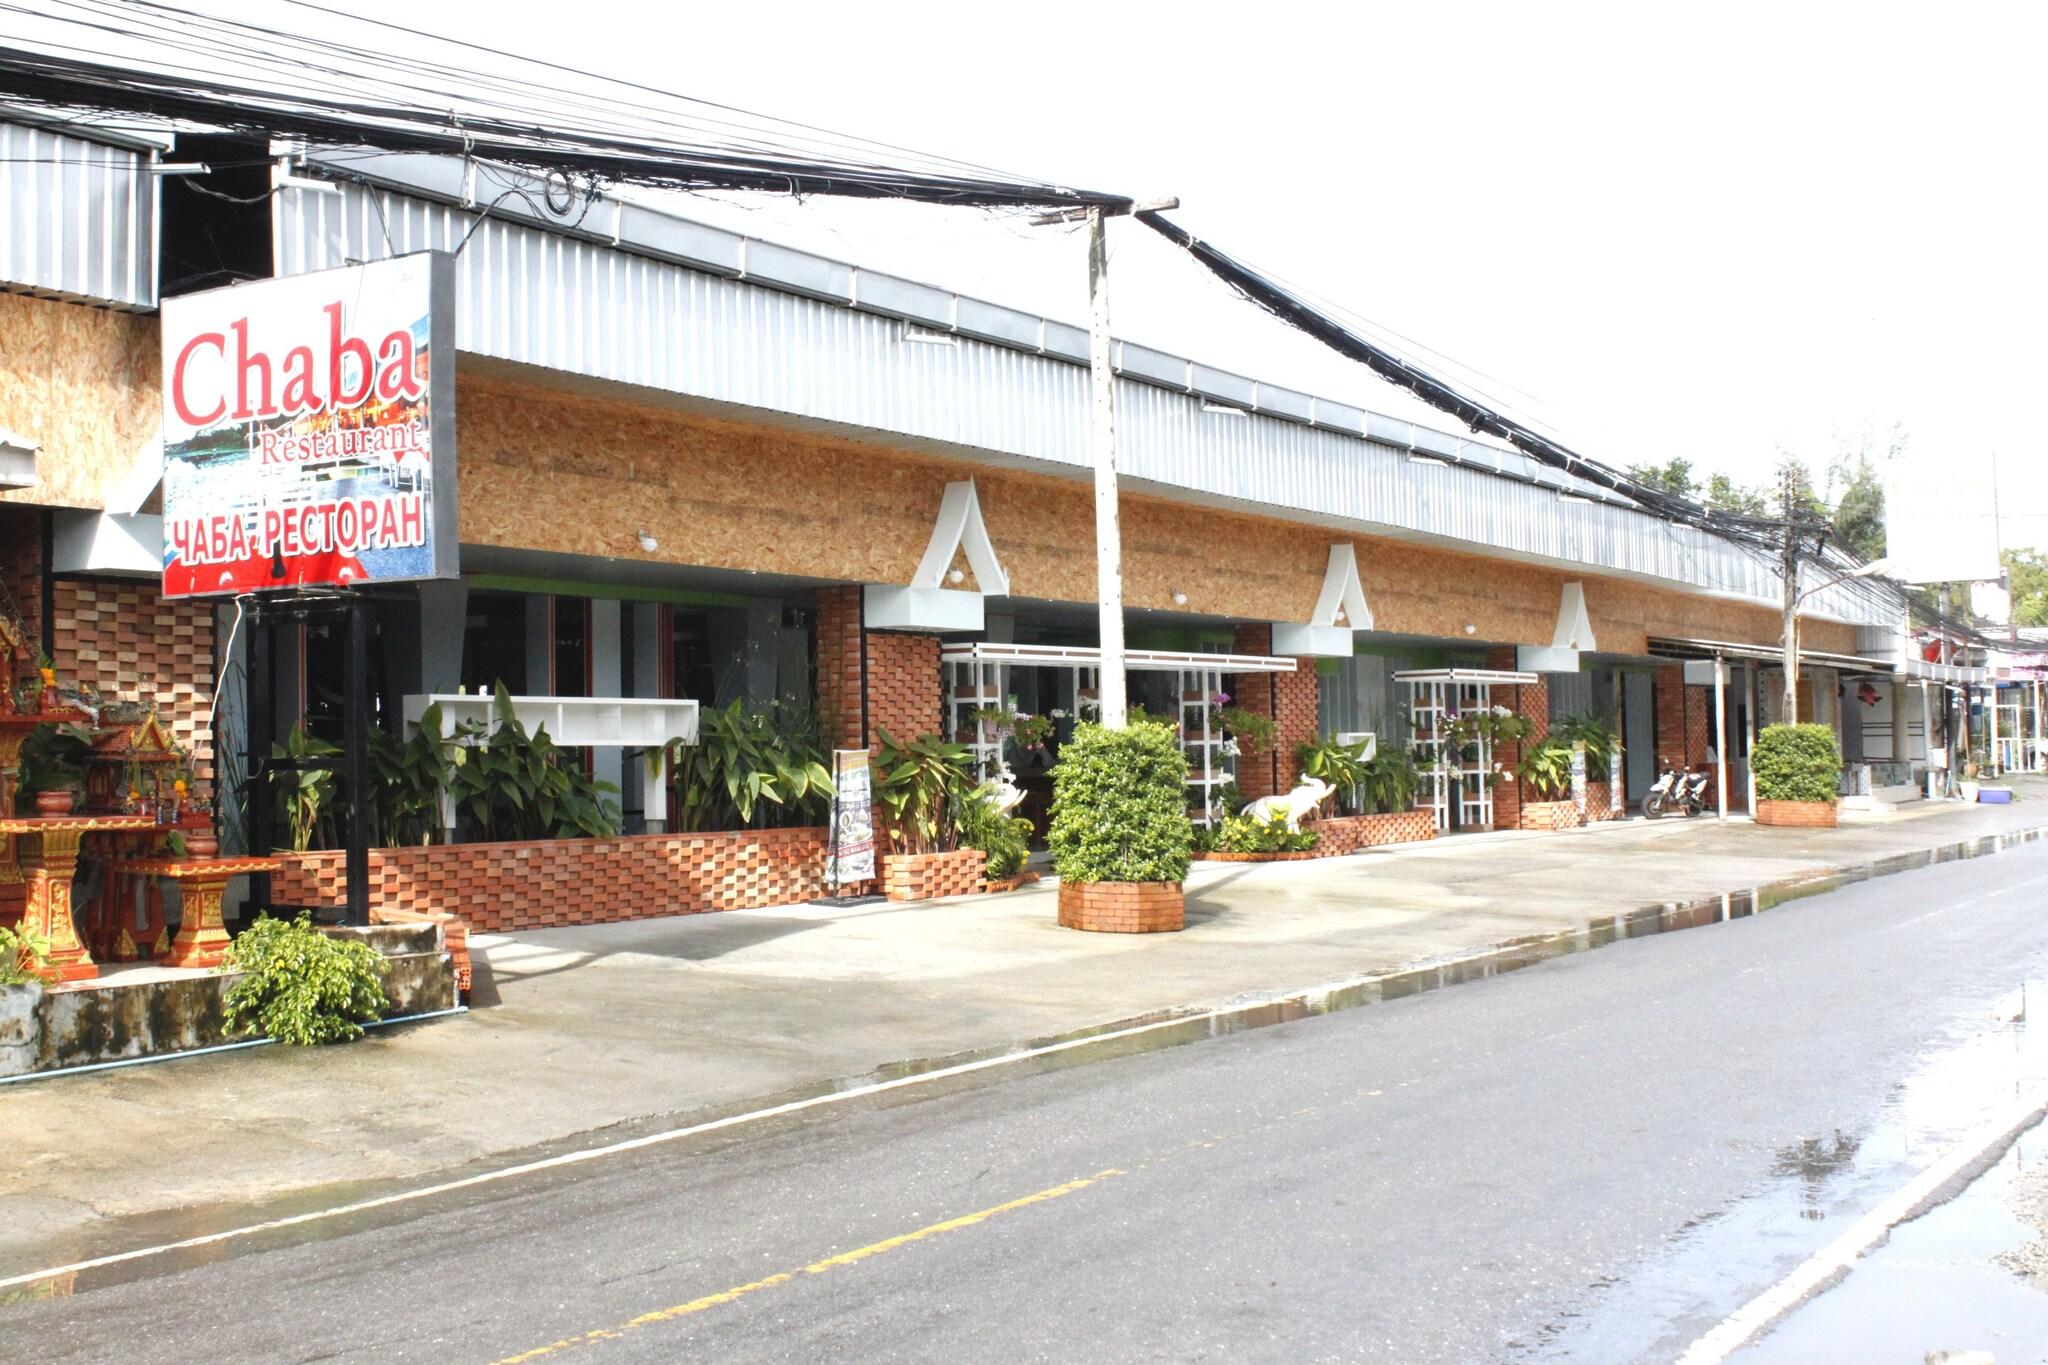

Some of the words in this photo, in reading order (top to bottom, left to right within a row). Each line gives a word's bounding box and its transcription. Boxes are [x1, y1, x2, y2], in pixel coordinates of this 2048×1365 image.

[172, 302, 421, 426] Chaba
[262, 422, 421, 464] Restaurant
[173, 514, 251, 566] ЧАБА
[264, 497, 422, 554] РЕСТОРАН
